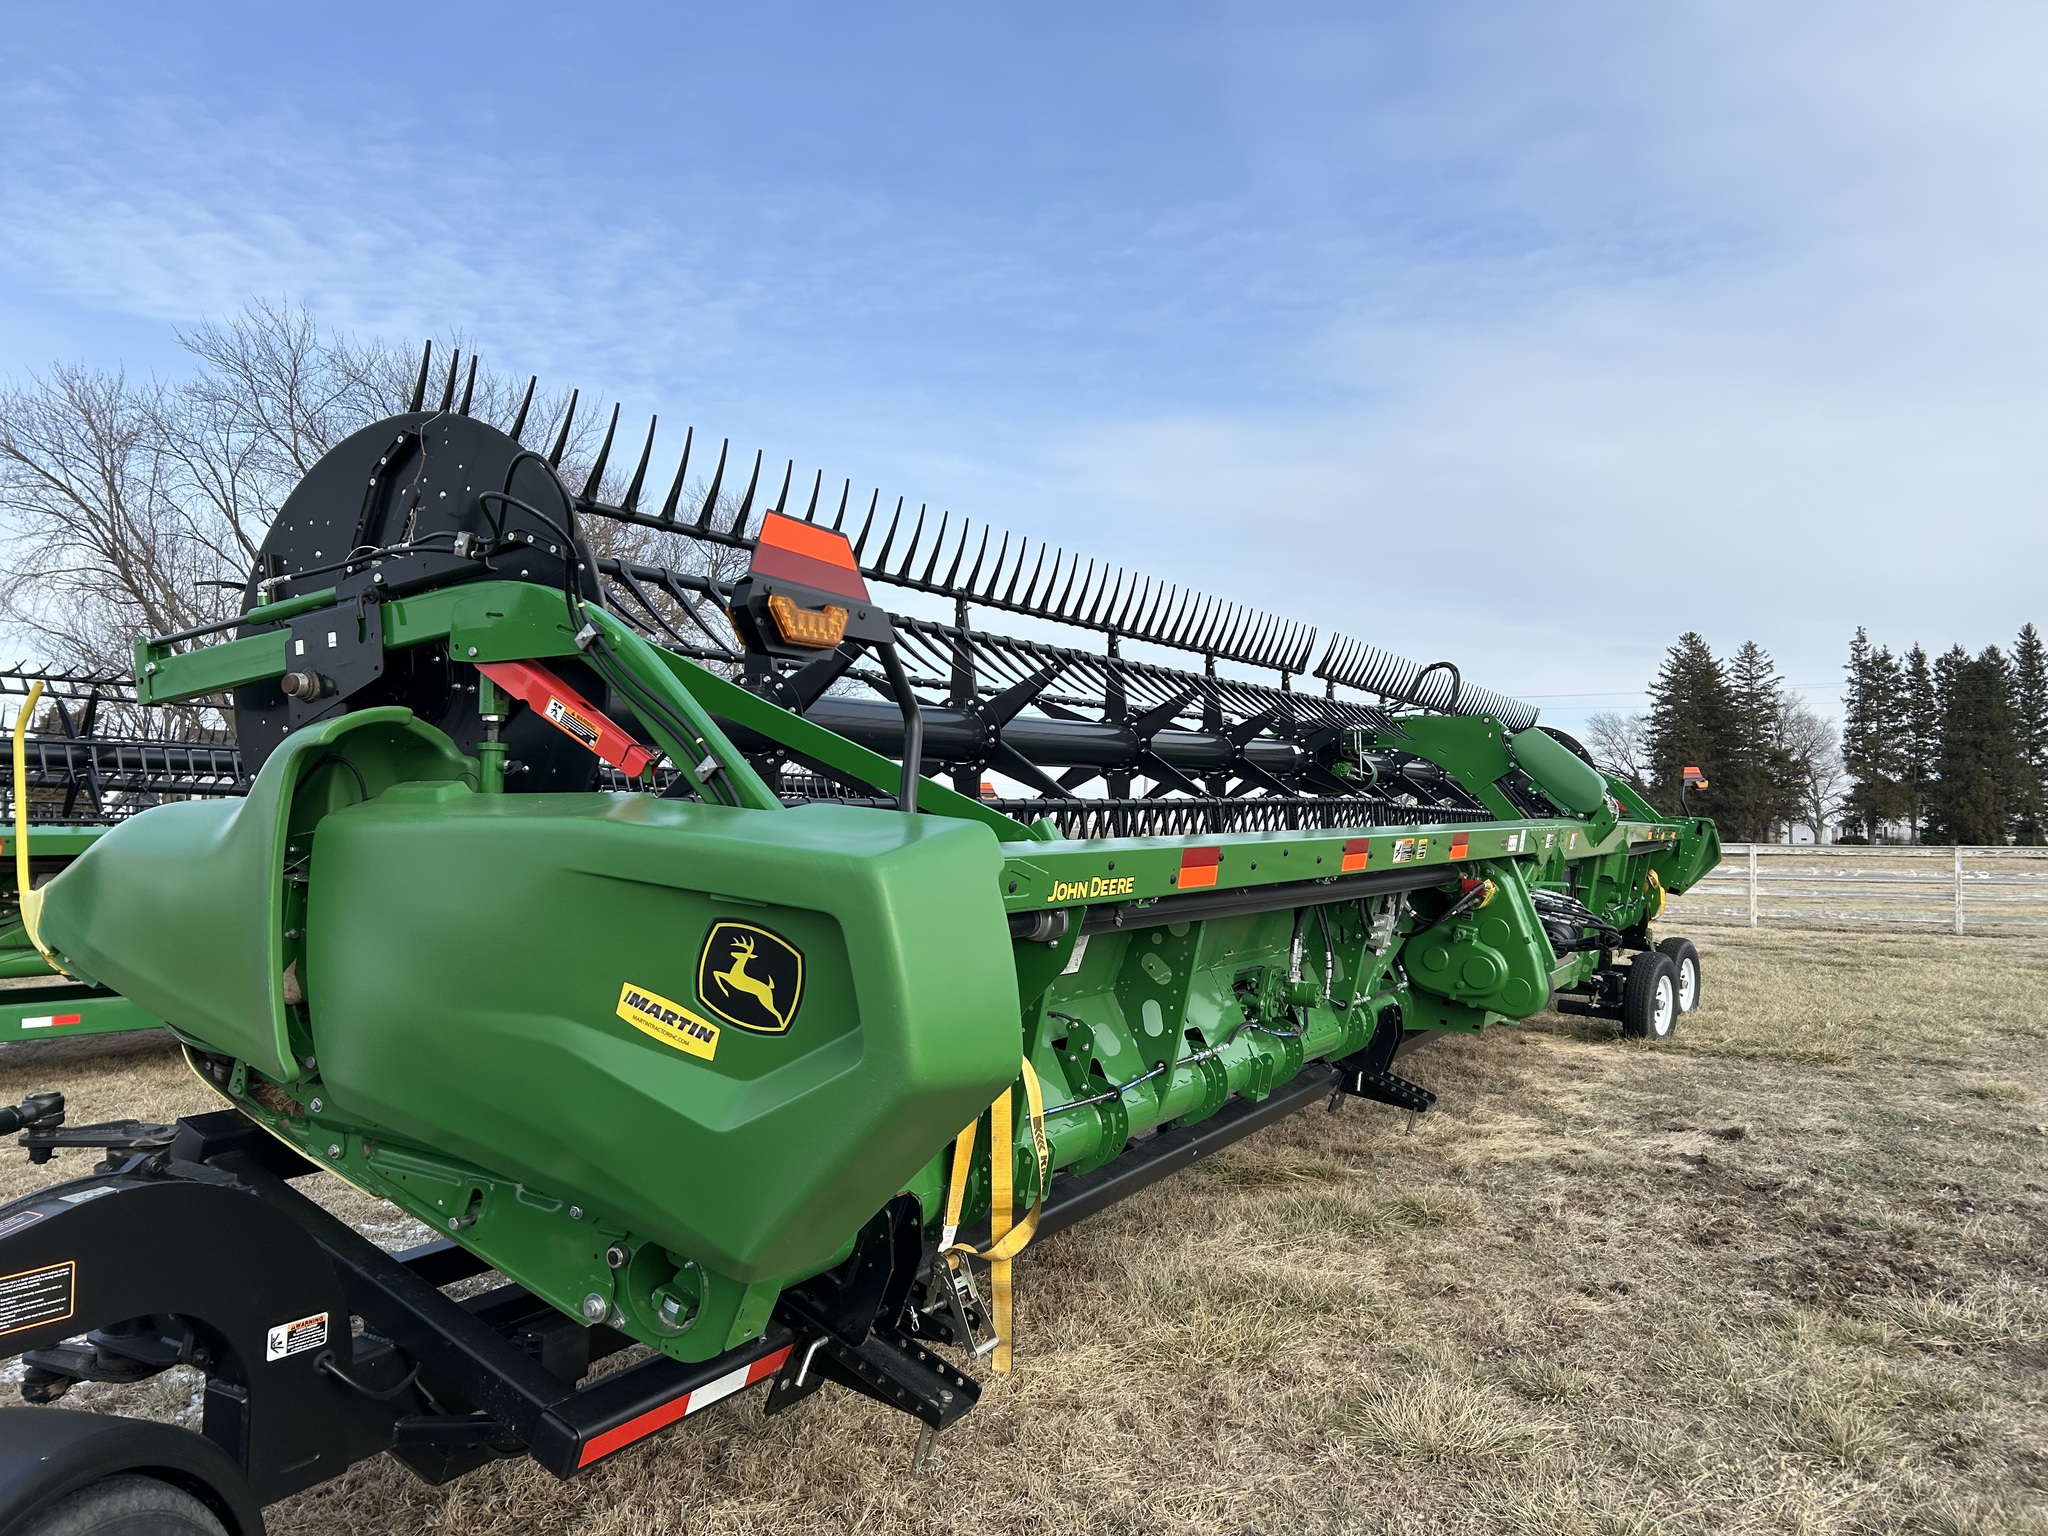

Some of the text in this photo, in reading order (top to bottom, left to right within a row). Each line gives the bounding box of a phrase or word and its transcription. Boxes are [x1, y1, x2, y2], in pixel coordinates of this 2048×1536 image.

[1046, 876, 1136, 903] JOHN DEERE
[627, 991, 716, 1044] MARTIN
